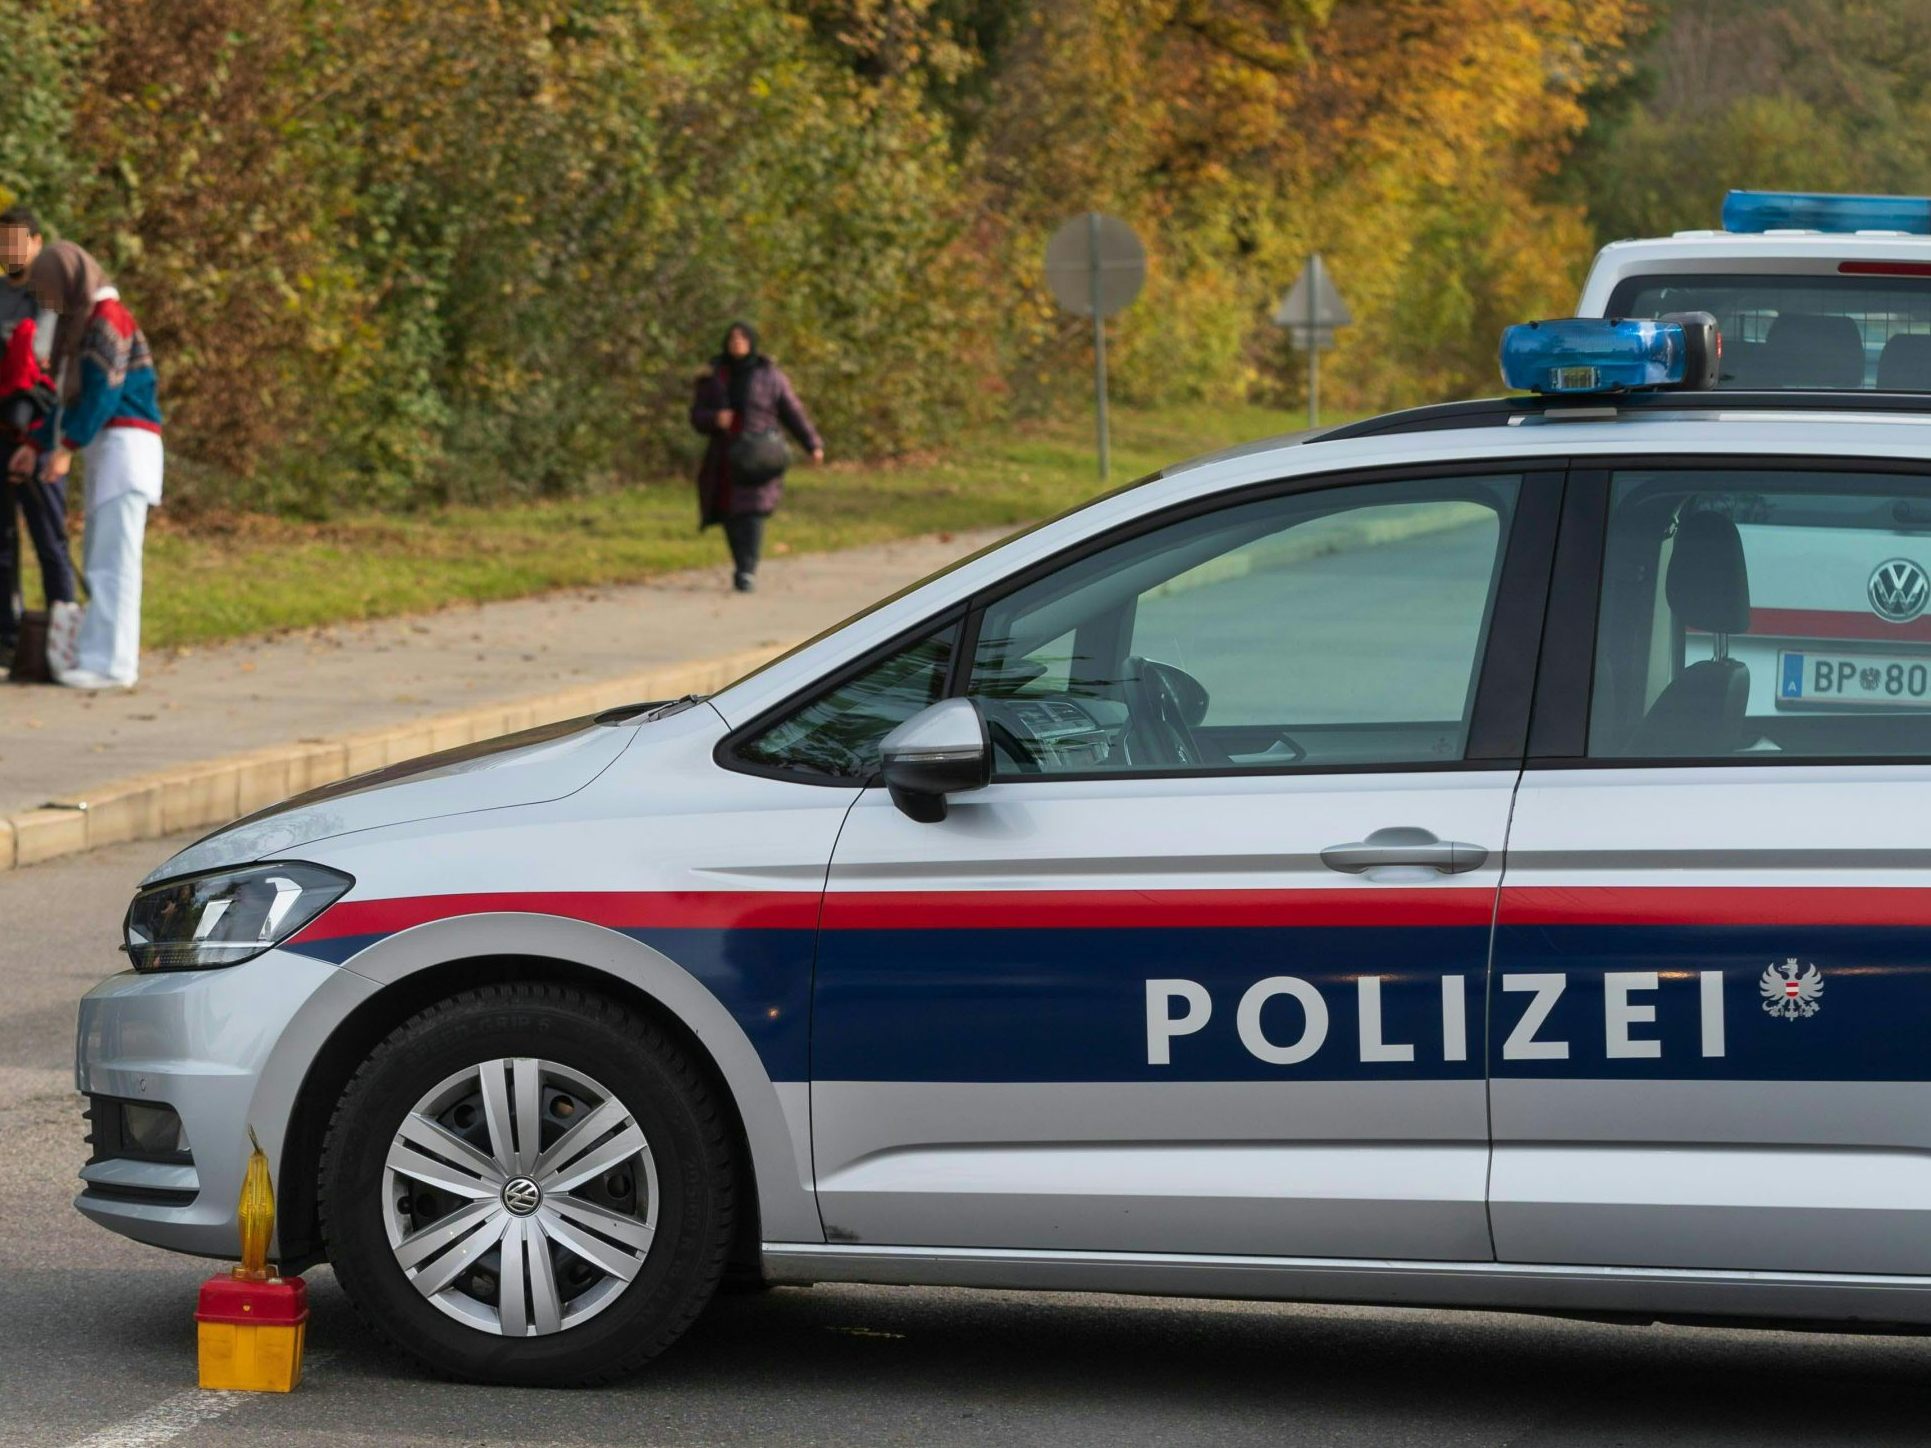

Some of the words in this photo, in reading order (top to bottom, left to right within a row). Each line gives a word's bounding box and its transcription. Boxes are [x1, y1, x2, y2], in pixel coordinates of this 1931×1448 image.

[1868, 558, 1930, 623] VW
[1787, 680, 1798, 692] A
[1814, 660, 1857, 694] BP
[1885, 663, 1927, 697] 80
[1145, 970, 1726, 1065] POLIZEI
